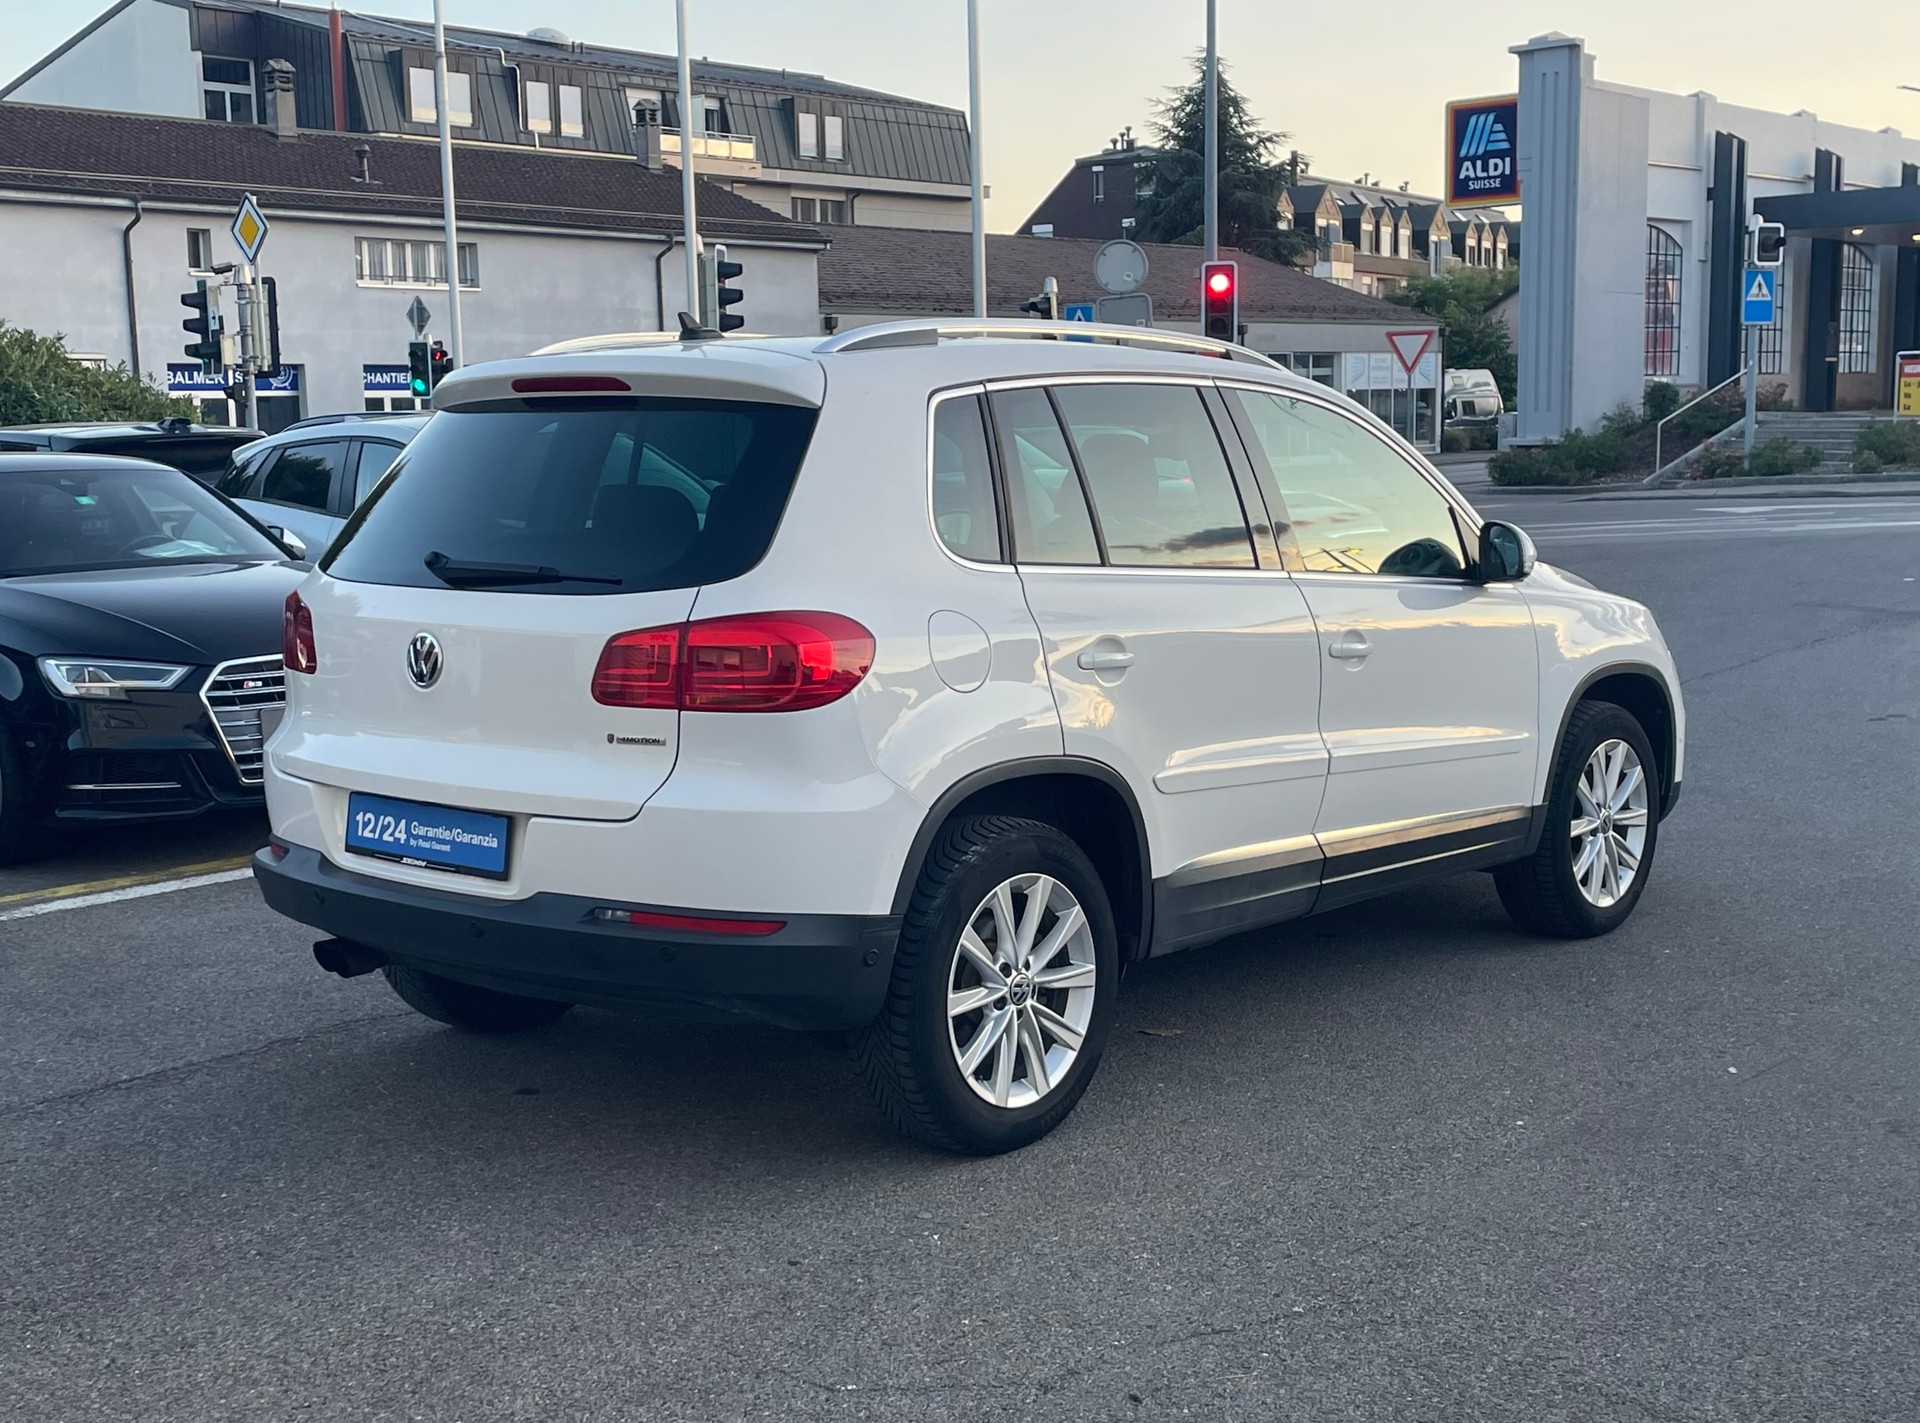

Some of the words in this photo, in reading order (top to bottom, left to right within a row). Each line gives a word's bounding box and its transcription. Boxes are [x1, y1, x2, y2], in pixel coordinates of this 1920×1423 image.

[1459, 157, 1511, 179] ALDI
[1468, 178, 1501, 190] SUISSE
[355, 811, 407, 844] 12/24
[411, 821, 498, 848] Garantie/Garanzia
[410, 837, 417, 848] by
